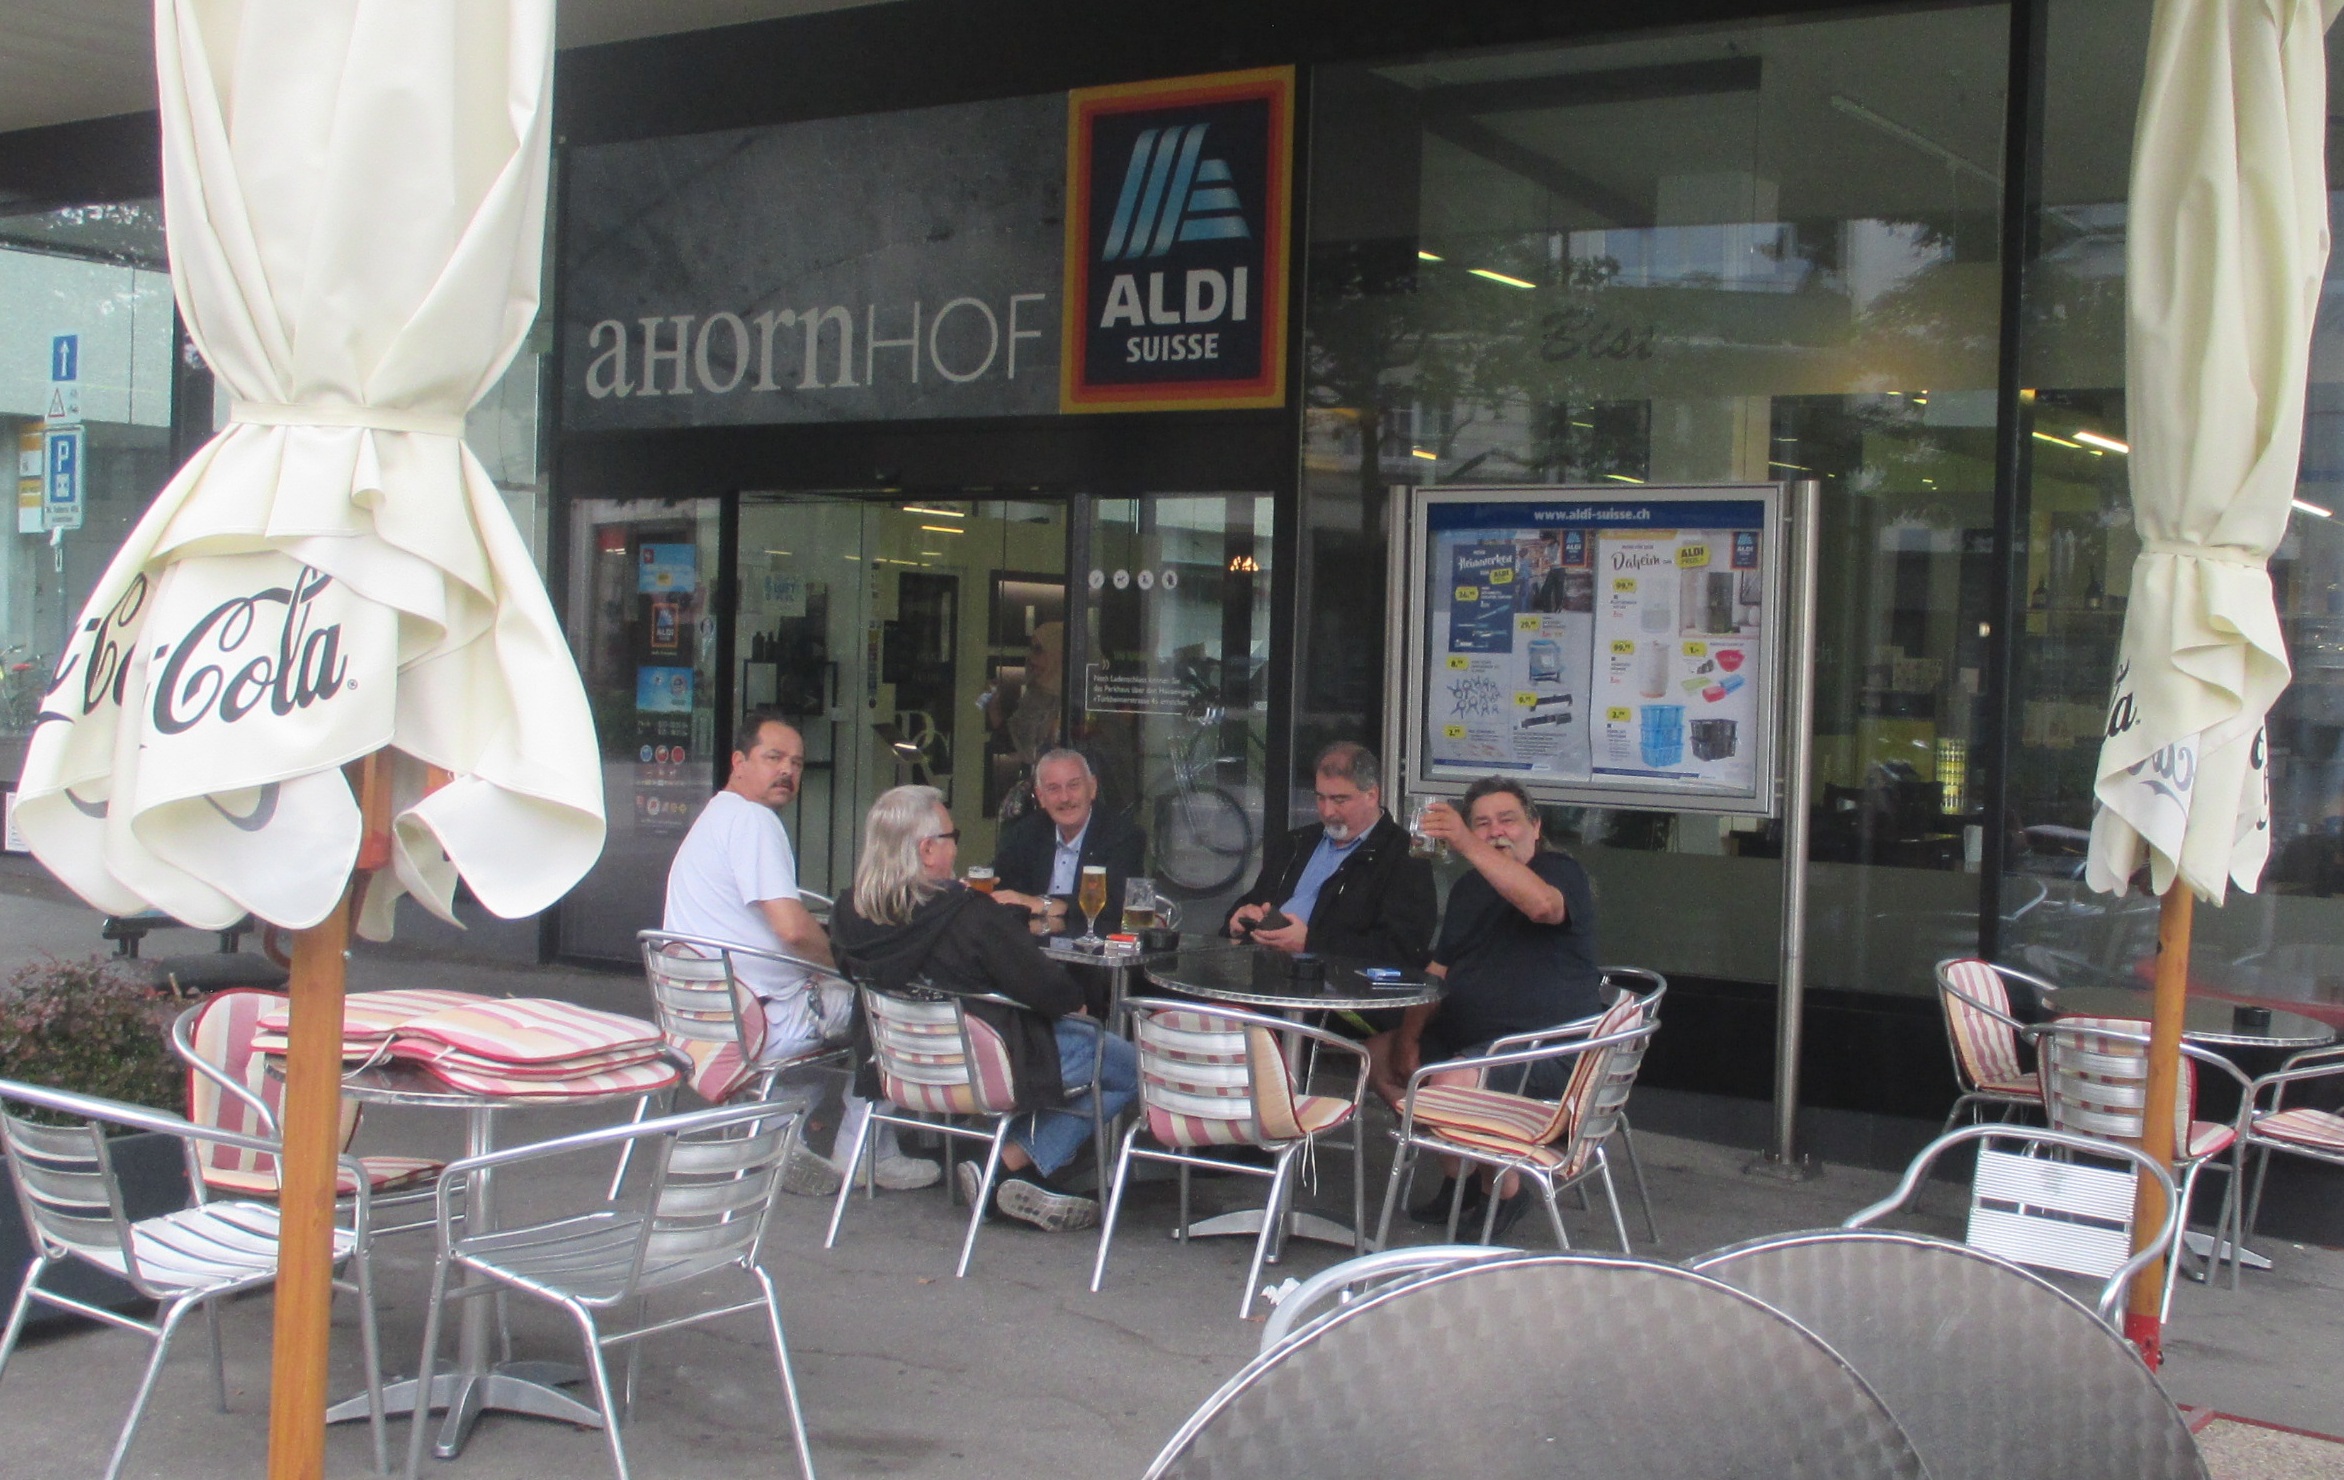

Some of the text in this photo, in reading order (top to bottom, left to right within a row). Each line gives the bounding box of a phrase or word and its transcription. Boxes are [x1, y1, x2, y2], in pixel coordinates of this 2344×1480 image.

[1100, 266, 1248, 328] ALDI
[1126, 333, 1220, 363] SUISSE
[1534, 507, 1650, 520] www.aldi-suisse.ch
[1611, 551, 1660, 571] Daheim
[1681, 547, 1704, 558] ALDI
